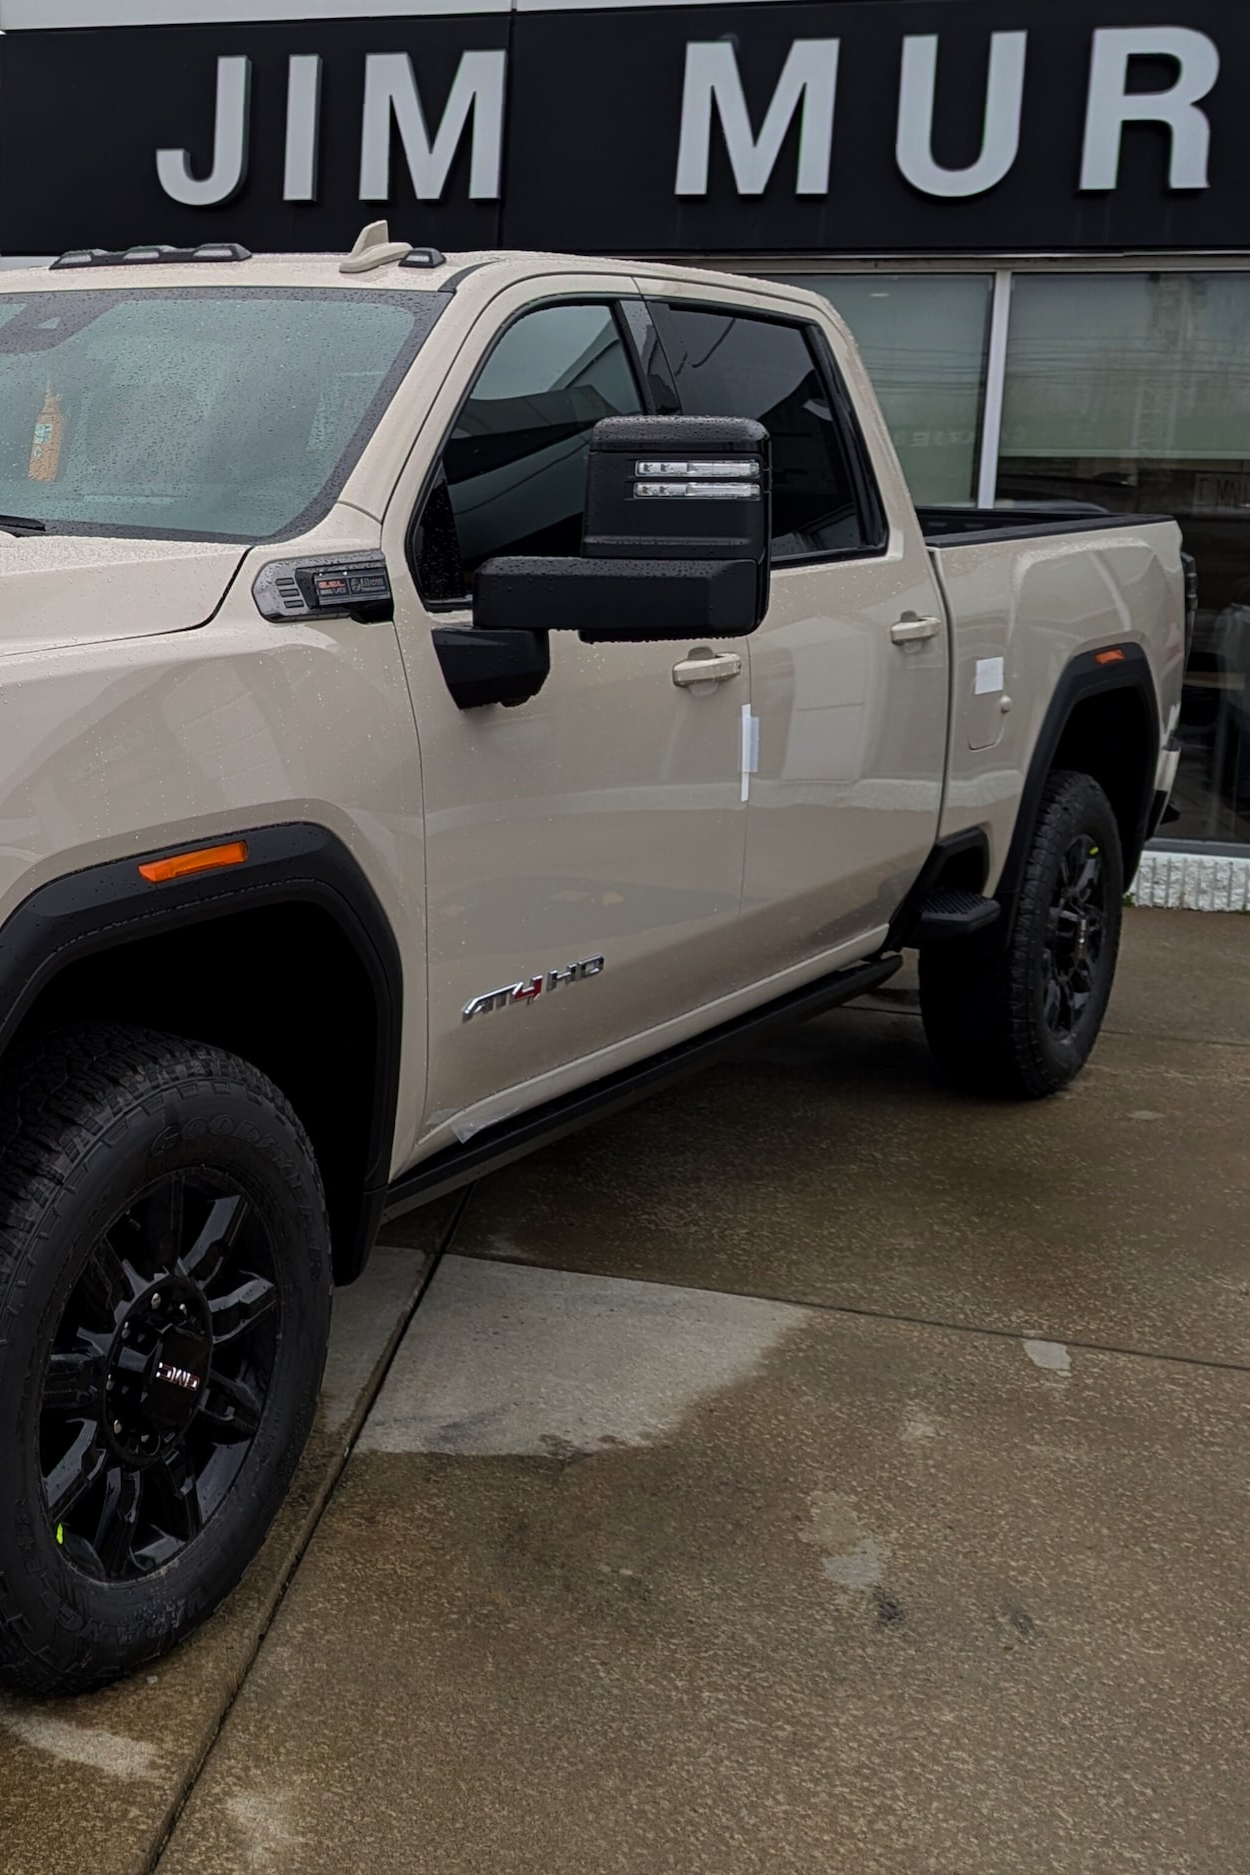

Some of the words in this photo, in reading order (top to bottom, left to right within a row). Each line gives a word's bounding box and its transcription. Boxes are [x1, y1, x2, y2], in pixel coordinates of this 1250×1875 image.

[156, 50, 507, 206] JIM
[675, 26, 1221, 198] MUR
[462, 974, 543, 1024] AT4
[546, 953, 604, 992] HD
[156, 1361, 200, 1391] GMC
